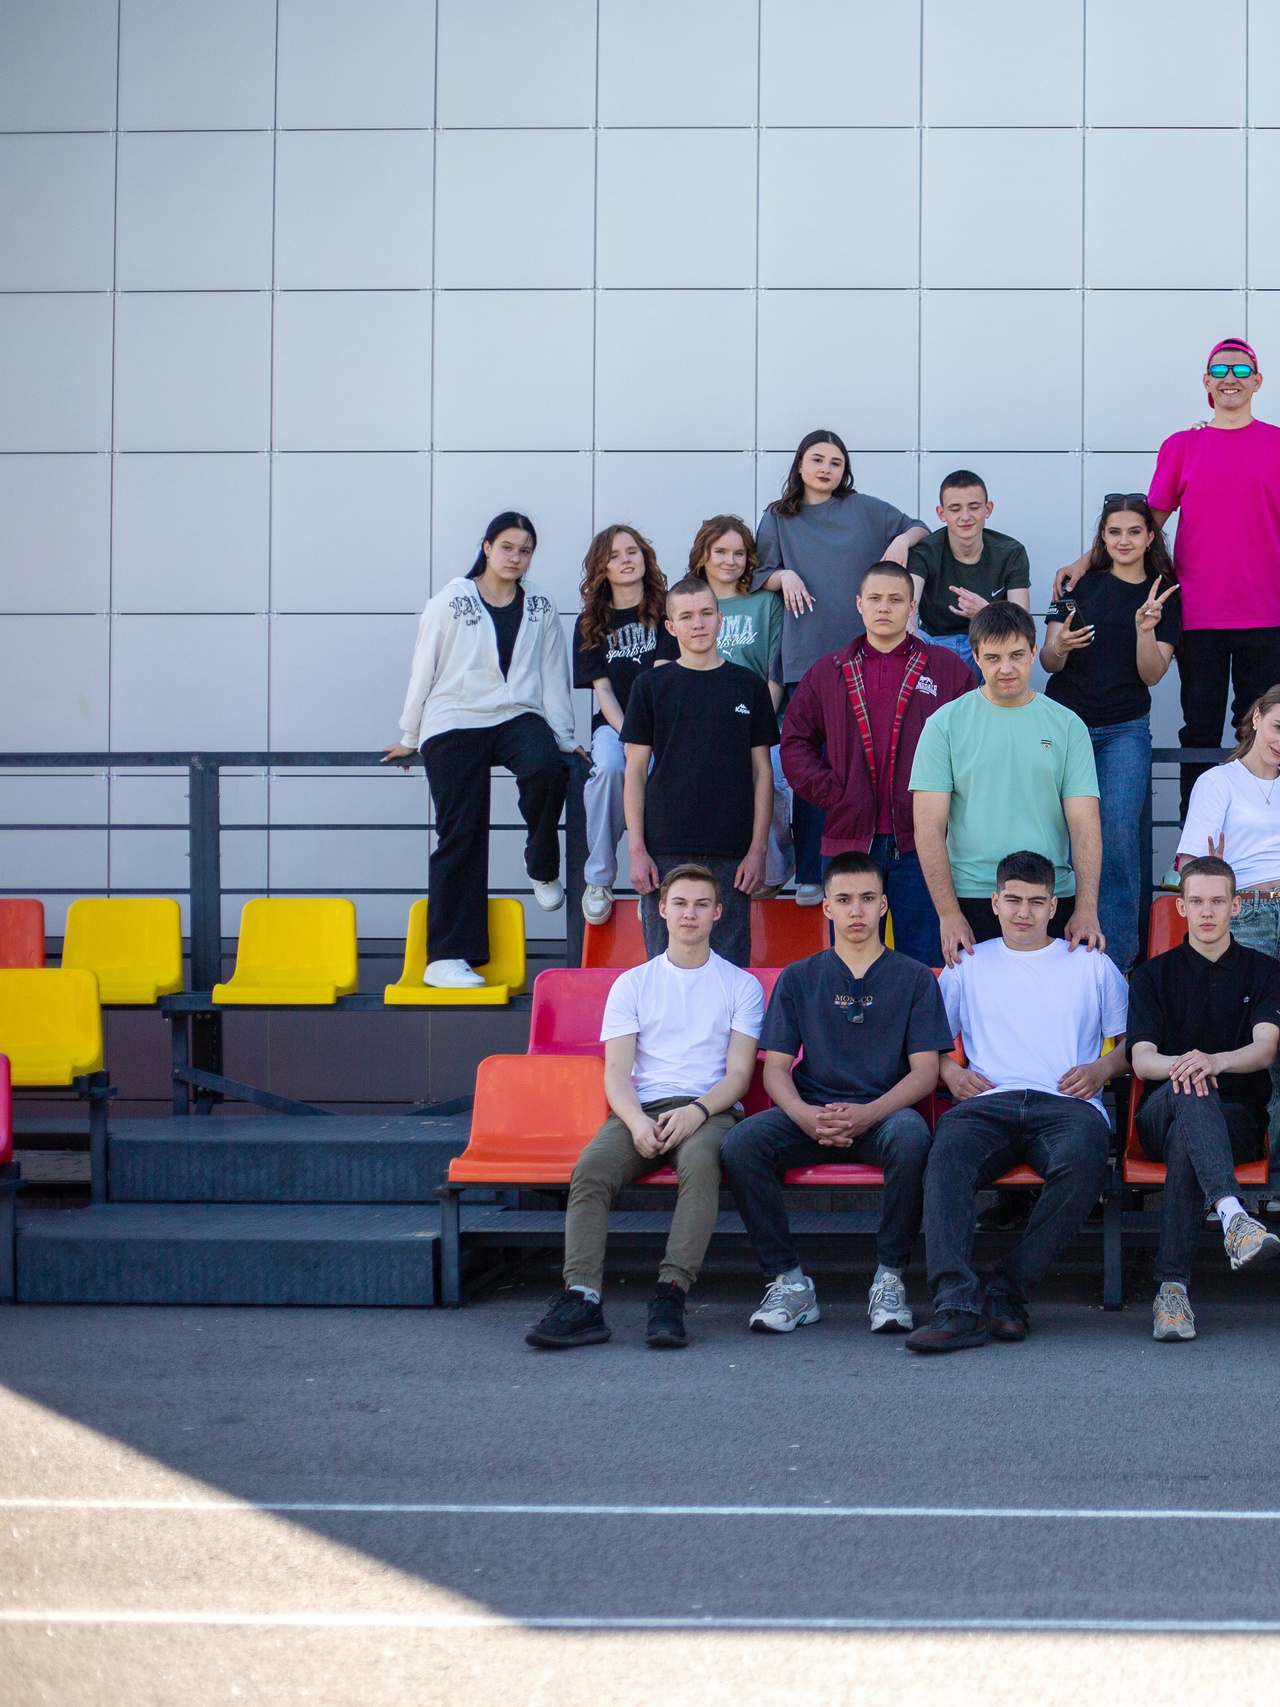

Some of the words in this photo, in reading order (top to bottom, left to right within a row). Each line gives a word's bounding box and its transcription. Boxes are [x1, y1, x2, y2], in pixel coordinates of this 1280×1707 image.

[731, 632, 758, 648] club
[605, 643, 640, 663] sports
[835, 995, 874, 1003] MONCO
